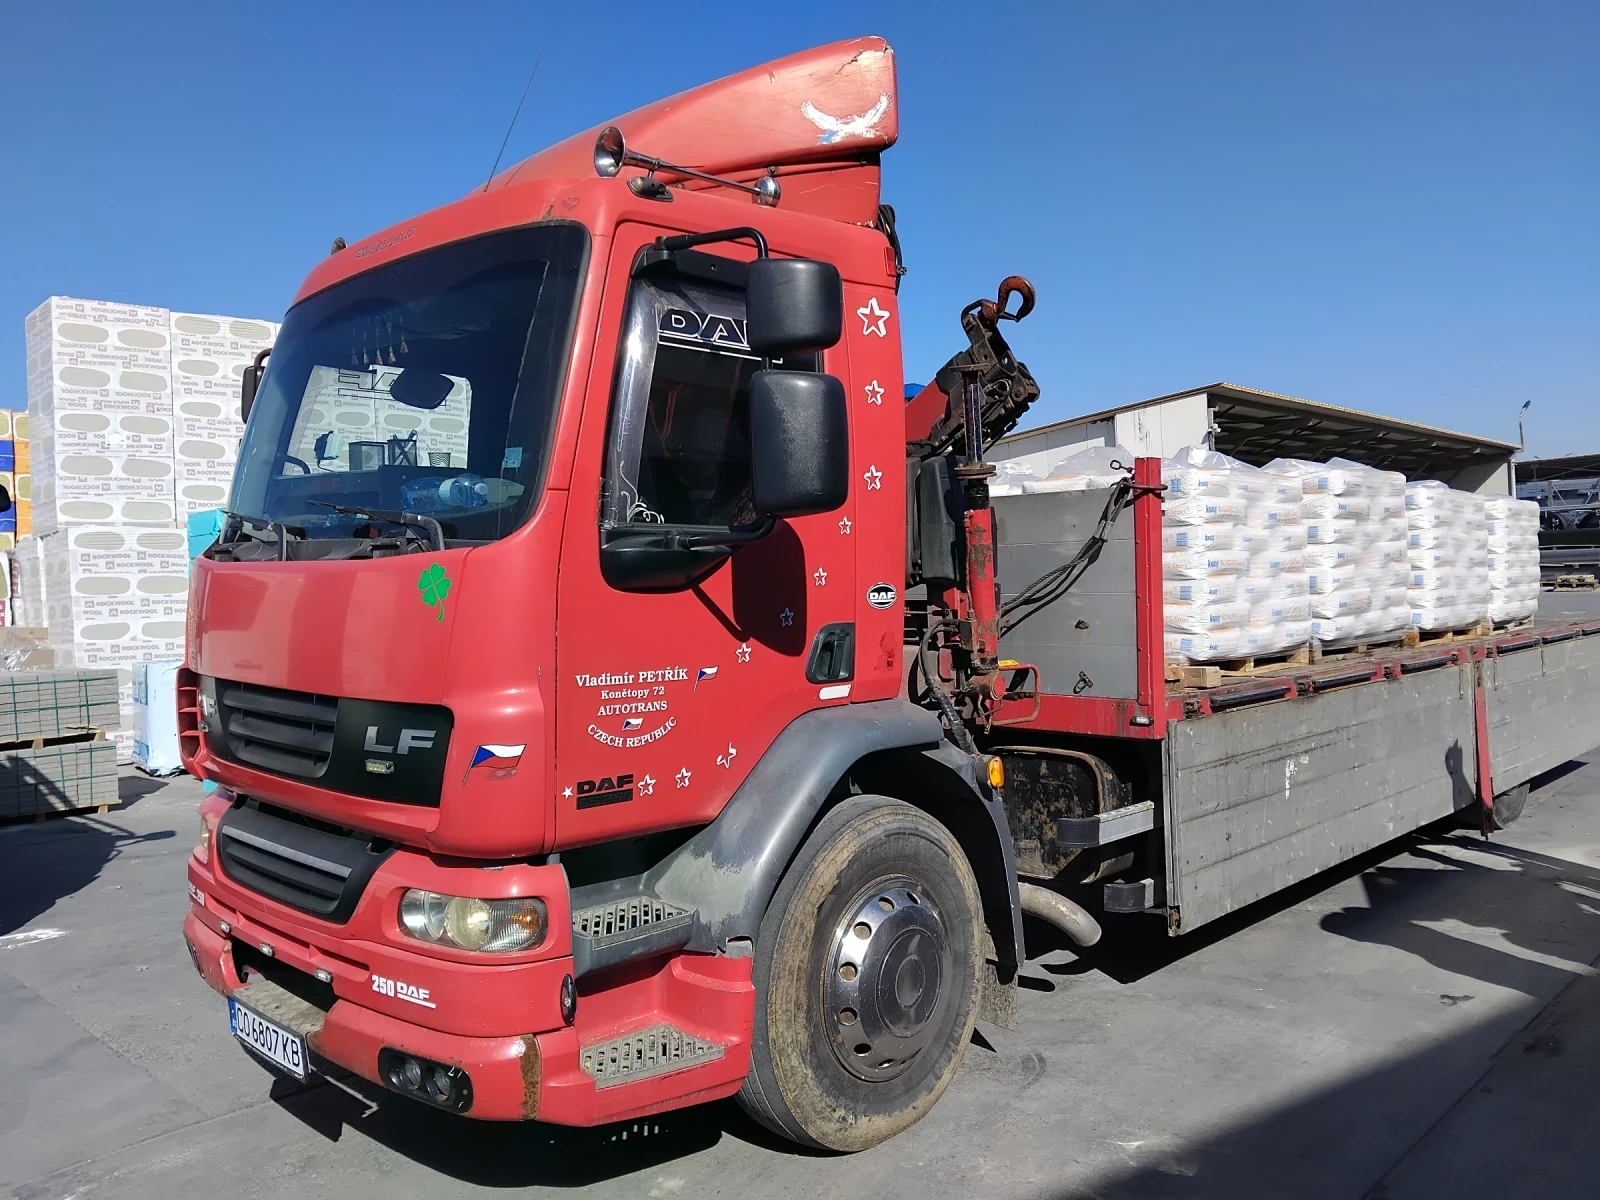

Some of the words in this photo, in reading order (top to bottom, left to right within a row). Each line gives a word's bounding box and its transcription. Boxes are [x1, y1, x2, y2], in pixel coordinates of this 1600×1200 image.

[870, 592, 895, 600] DAF
[575, 672, 635, 687] Vladimír
[638, 666, 688, 683] PETŘÍK
[601, 688, 649, 700] Konětopy
[653, 686, 665, 696] 72
[597, 700, 668, 716] AUTOTRANS
[364, 726, 436, 754] LF
[587, 724, 623, 748] CZECH
[626, 716, 678, 748] REPUBLIC
[576, 774, 634, 796] DAF
[372, 974, 394, 997] 250
[397, 981, 430, 1000] DAF
